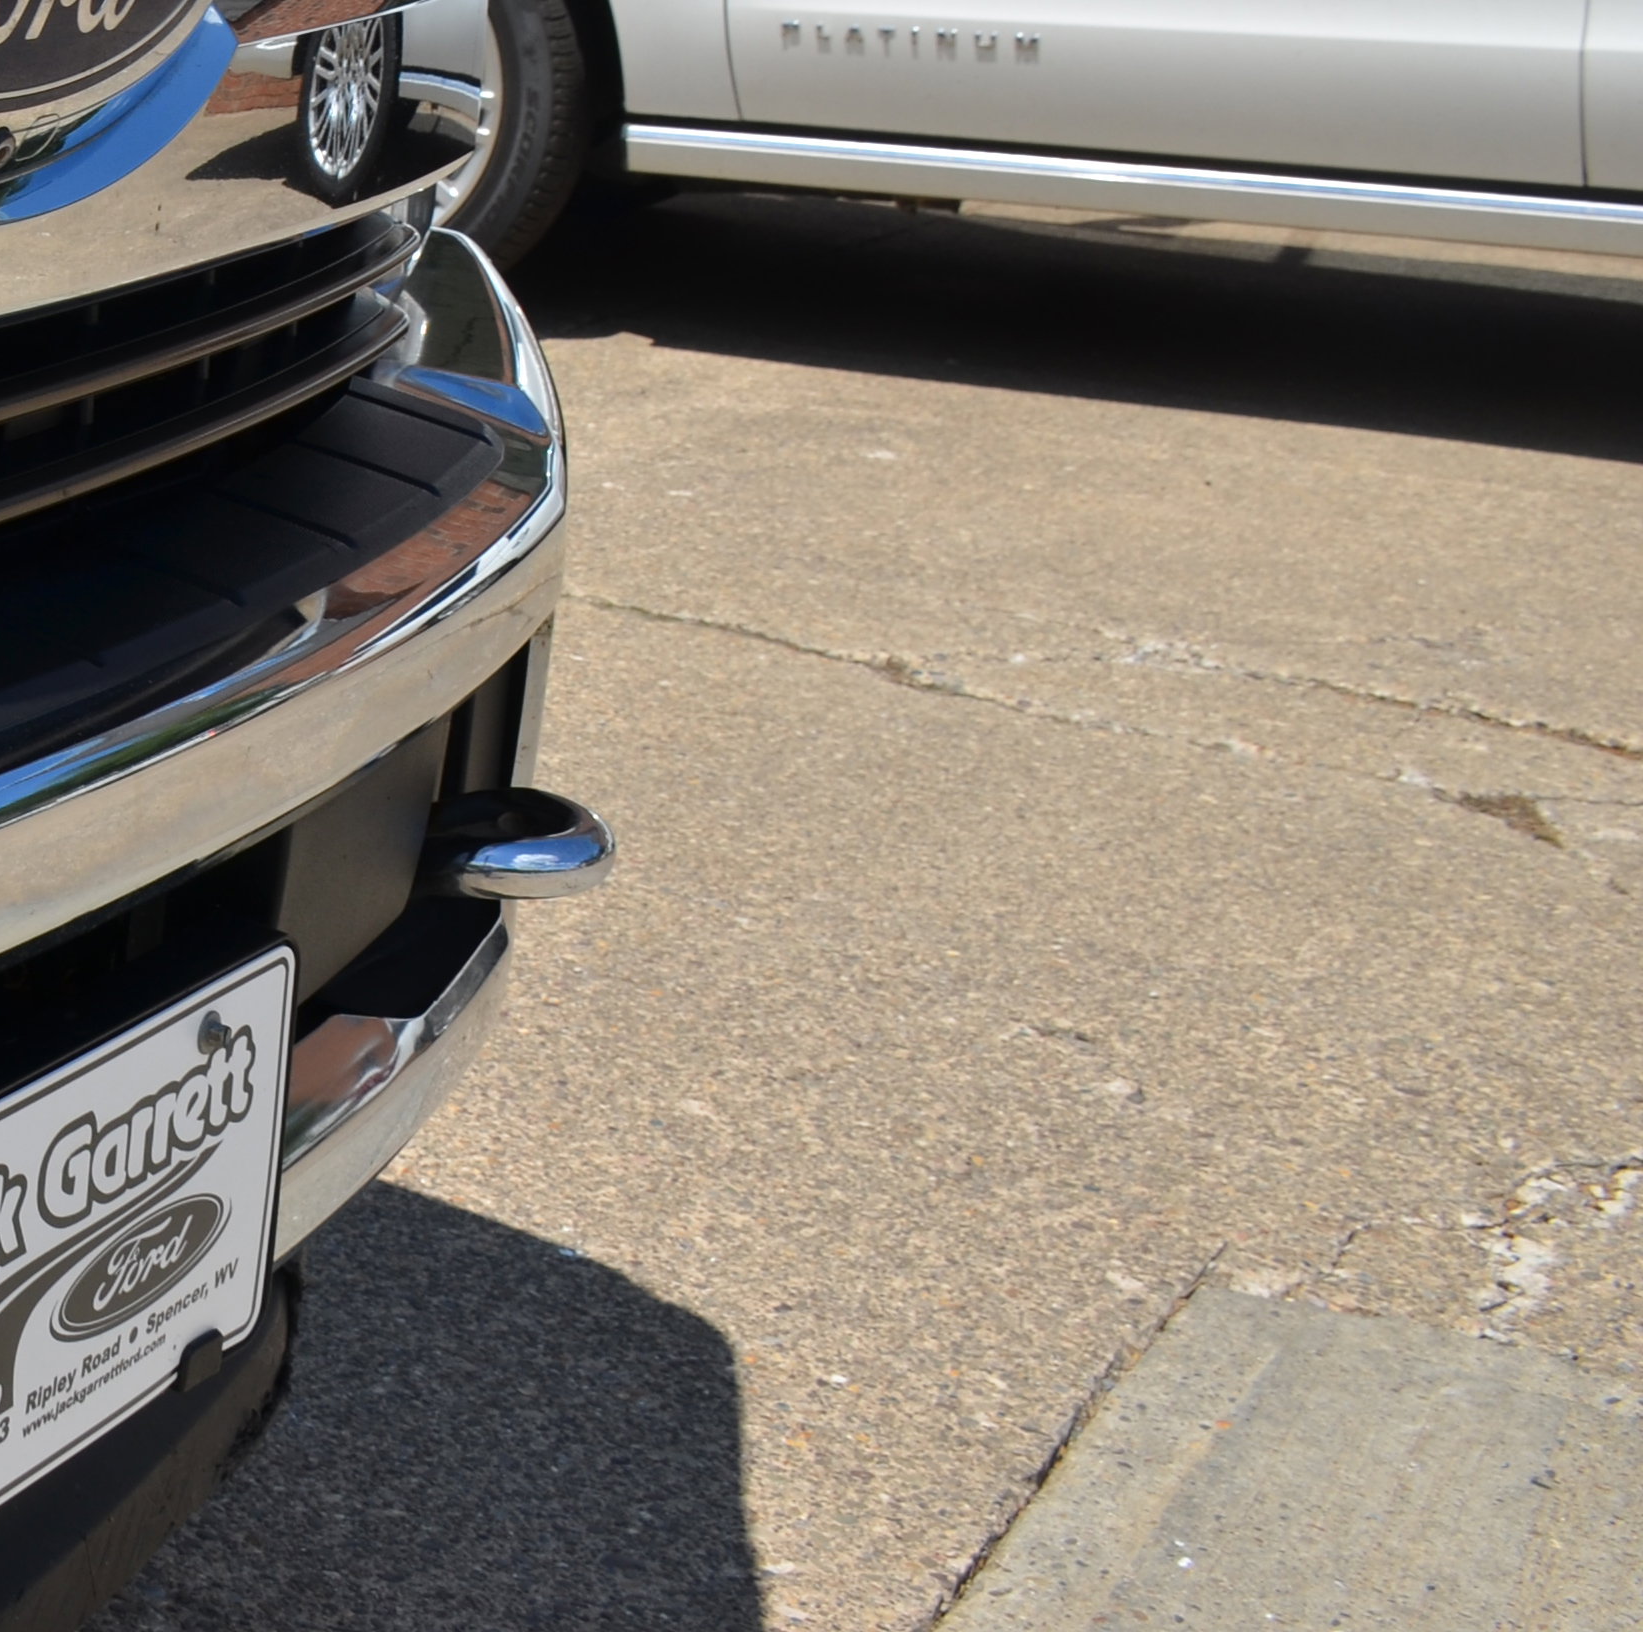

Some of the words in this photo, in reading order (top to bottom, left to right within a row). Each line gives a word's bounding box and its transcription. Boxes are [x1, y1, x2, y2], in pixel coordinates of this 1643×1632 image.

[781, 18, 1042, 62] PLATINUM
[37, 1025, 256, 1229] Garrett
[92, 1214, 194, 1312] Ford
[21, 1333, 167, 1439] www.jackgarrettford.com
[24, 1367, 78, 1415] Ripley
[80, 1334, 122, 1379] Road
[145, 1279, 210, 1335] Spencer,
[214, 1256, 240, 1289] WV
